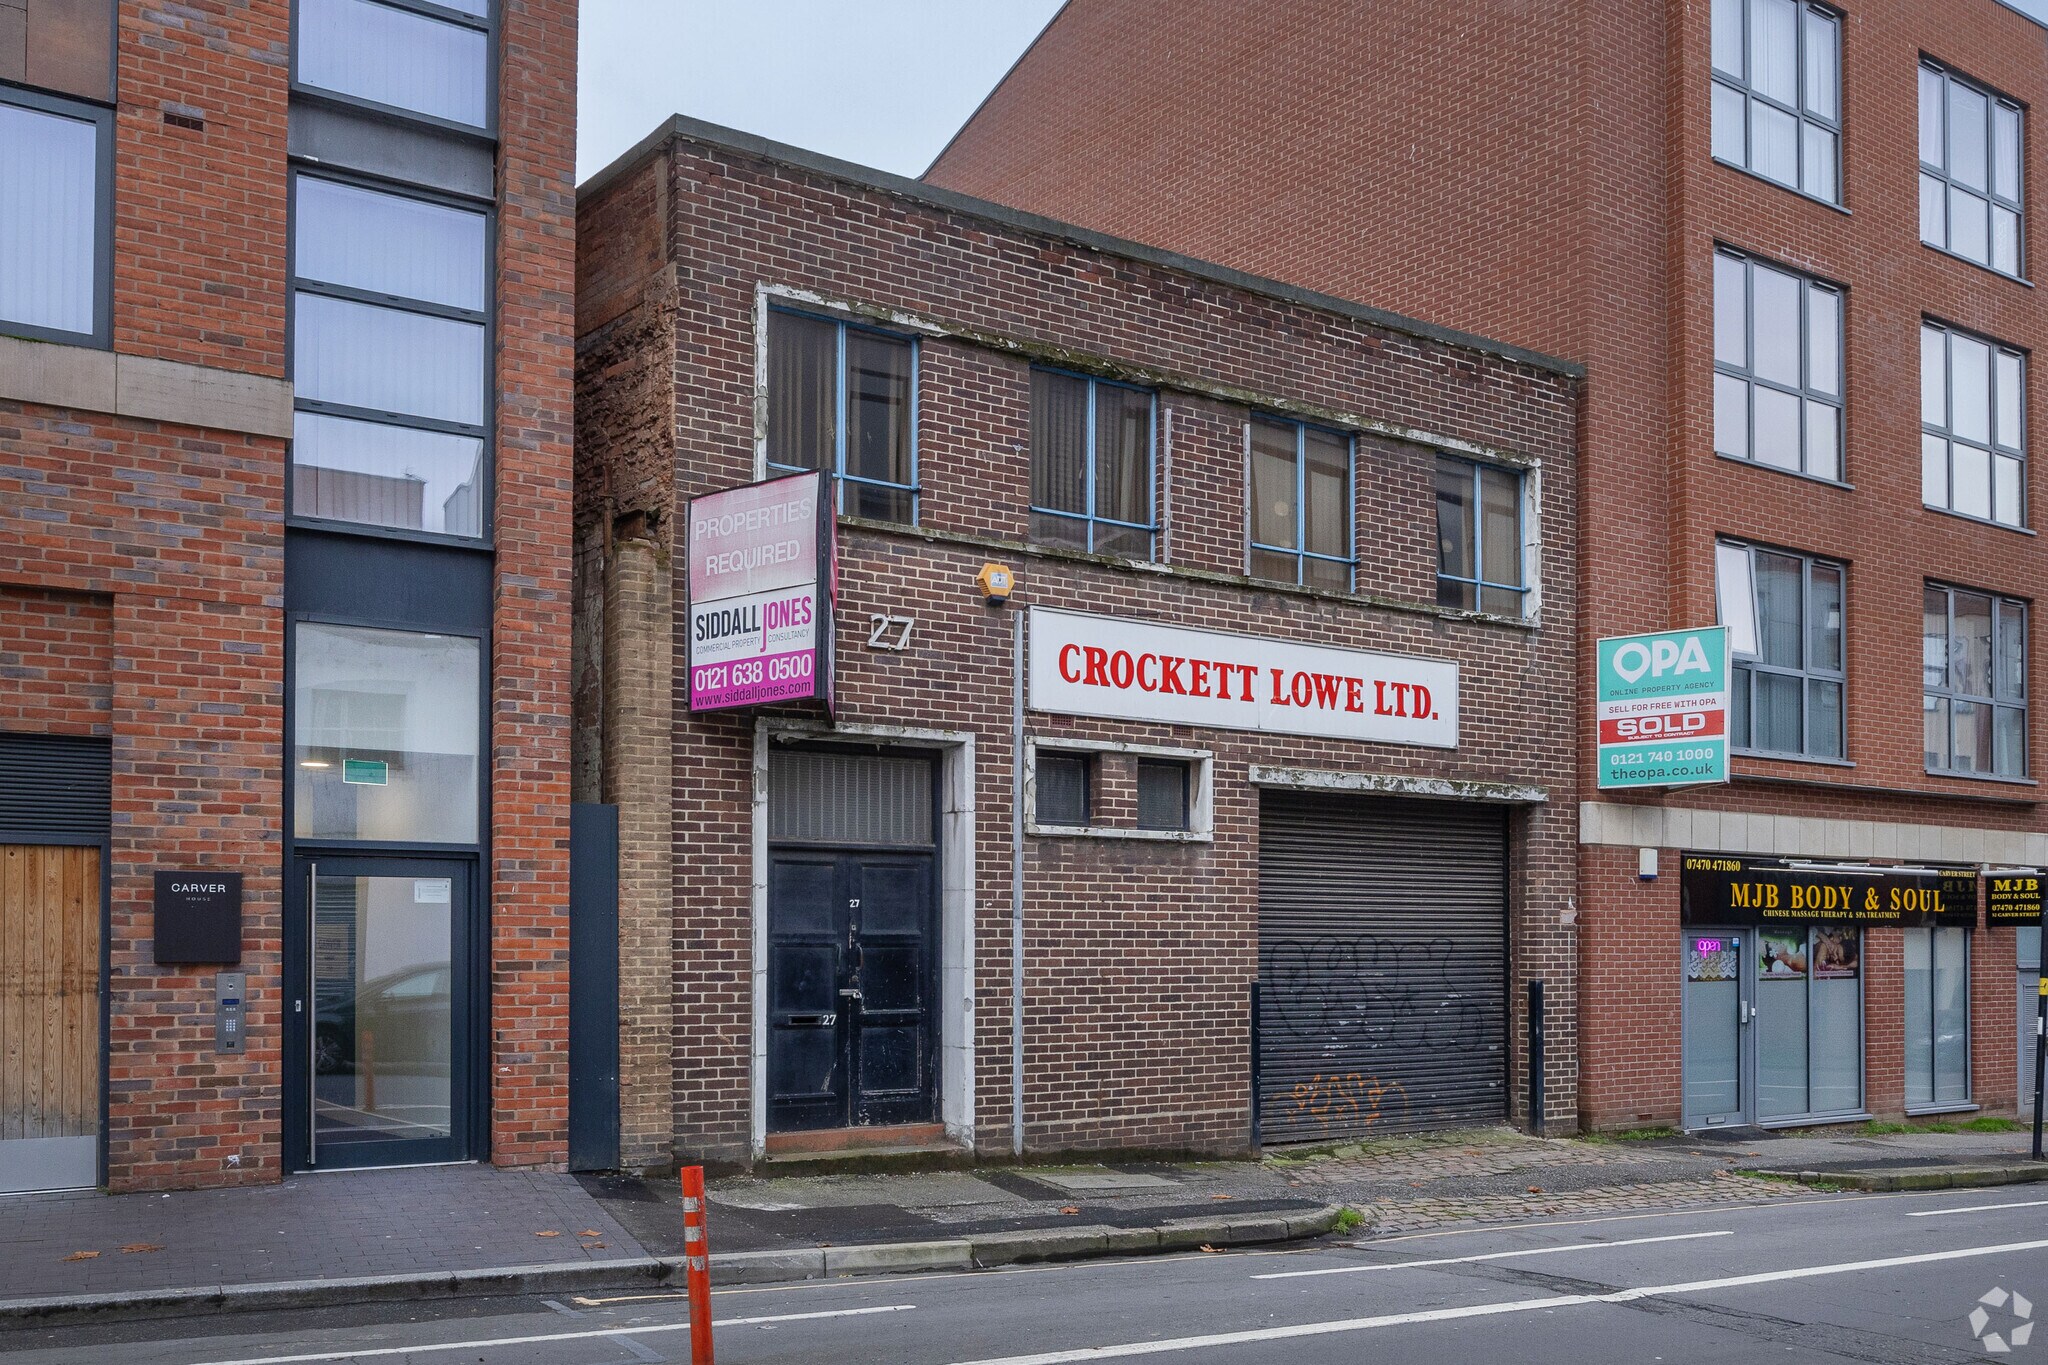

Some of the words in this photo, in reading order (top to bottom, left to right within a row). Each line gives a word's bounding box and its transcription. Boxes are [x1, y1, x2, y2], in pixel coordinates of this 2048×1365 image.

[695, 498, 812, 541] PROPERTIES
[706, 539, 800, 577] REQUIRED
[696, 604, 760, 642] SIDDALL
[760, 596, 812, 652] JONES
[868, 613, 915, 651] 27
[696, 641, 732, 655] COMMERCIAL
[732, 636, 760, 651] PROPERTY
[768, 628, 810, 644] CONSULTANCY
[1612, 636, 1712, 684] OPA
[695, 666, 728, 692] 0121
[732, 660, 763, 684] 638
[768, 654, 812, 680] 0500
[1058, 643, 1259, 703] CROCKETT
[1270, 667, 1364, 713] LOWE
[1373, 680, 1439, 722] LTD.
[695, 681, 811, 707] www.siddalljones.com
[1610, 688, 1638, 696] ONLINE
[1642, 684, 1681, 694] PROPERTY
[1684, 681, 1715, 690] AGENCY
[1608, 706, 1630, 714] SELL
[1650, 702, 1672, 710] FREE
[1674, 700, 1697, 708] WITH
[1699, 698, 1717, 706] OPA
[1617, 713, 1706, 736] SOLD
[1611, 753, 1644, 766] 0121
[1648, 750, 1673, 764] 740
[1676, 748, 1714, 761] 1000
[1611, 763, 1714, 781] theopa.co.uk
[1686, 859, 1711, 870] 07470
[1712, 860, 1741, 872] 471860
[171, 883, 226, 893] CARVER
[1730, 882, 1779, 908] MJB
[1790, 885, 1854, 910] BODY
[1865, 887, 1880, 911] &
[1890, 888, 1945, 912] SOUL
[1994, 879, 2038, 892] MJB
[850, 900, 860, 908] 27
[1698, 940, 1720, 958] open
[822, 1014, 837, 1026] 27
